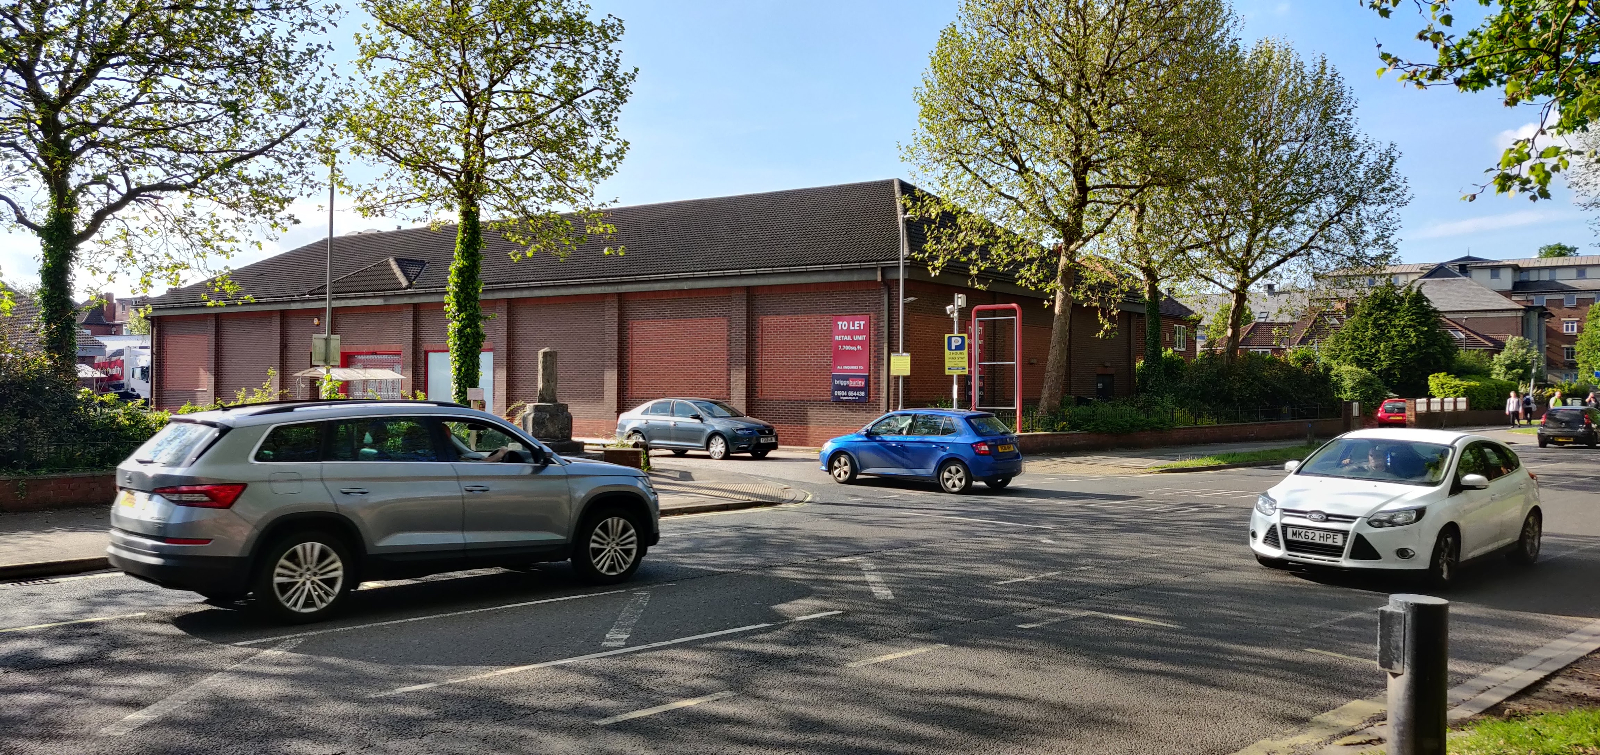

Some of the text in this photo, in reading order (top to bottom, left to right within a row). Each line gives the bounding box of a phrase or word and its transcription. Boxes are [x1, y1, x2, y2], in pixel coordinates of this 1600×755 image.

[838, 321, 865, 330] TO LET
[951, 337, 961, 350] P
[1291, 529, 1338, 544] MK62 HPE
